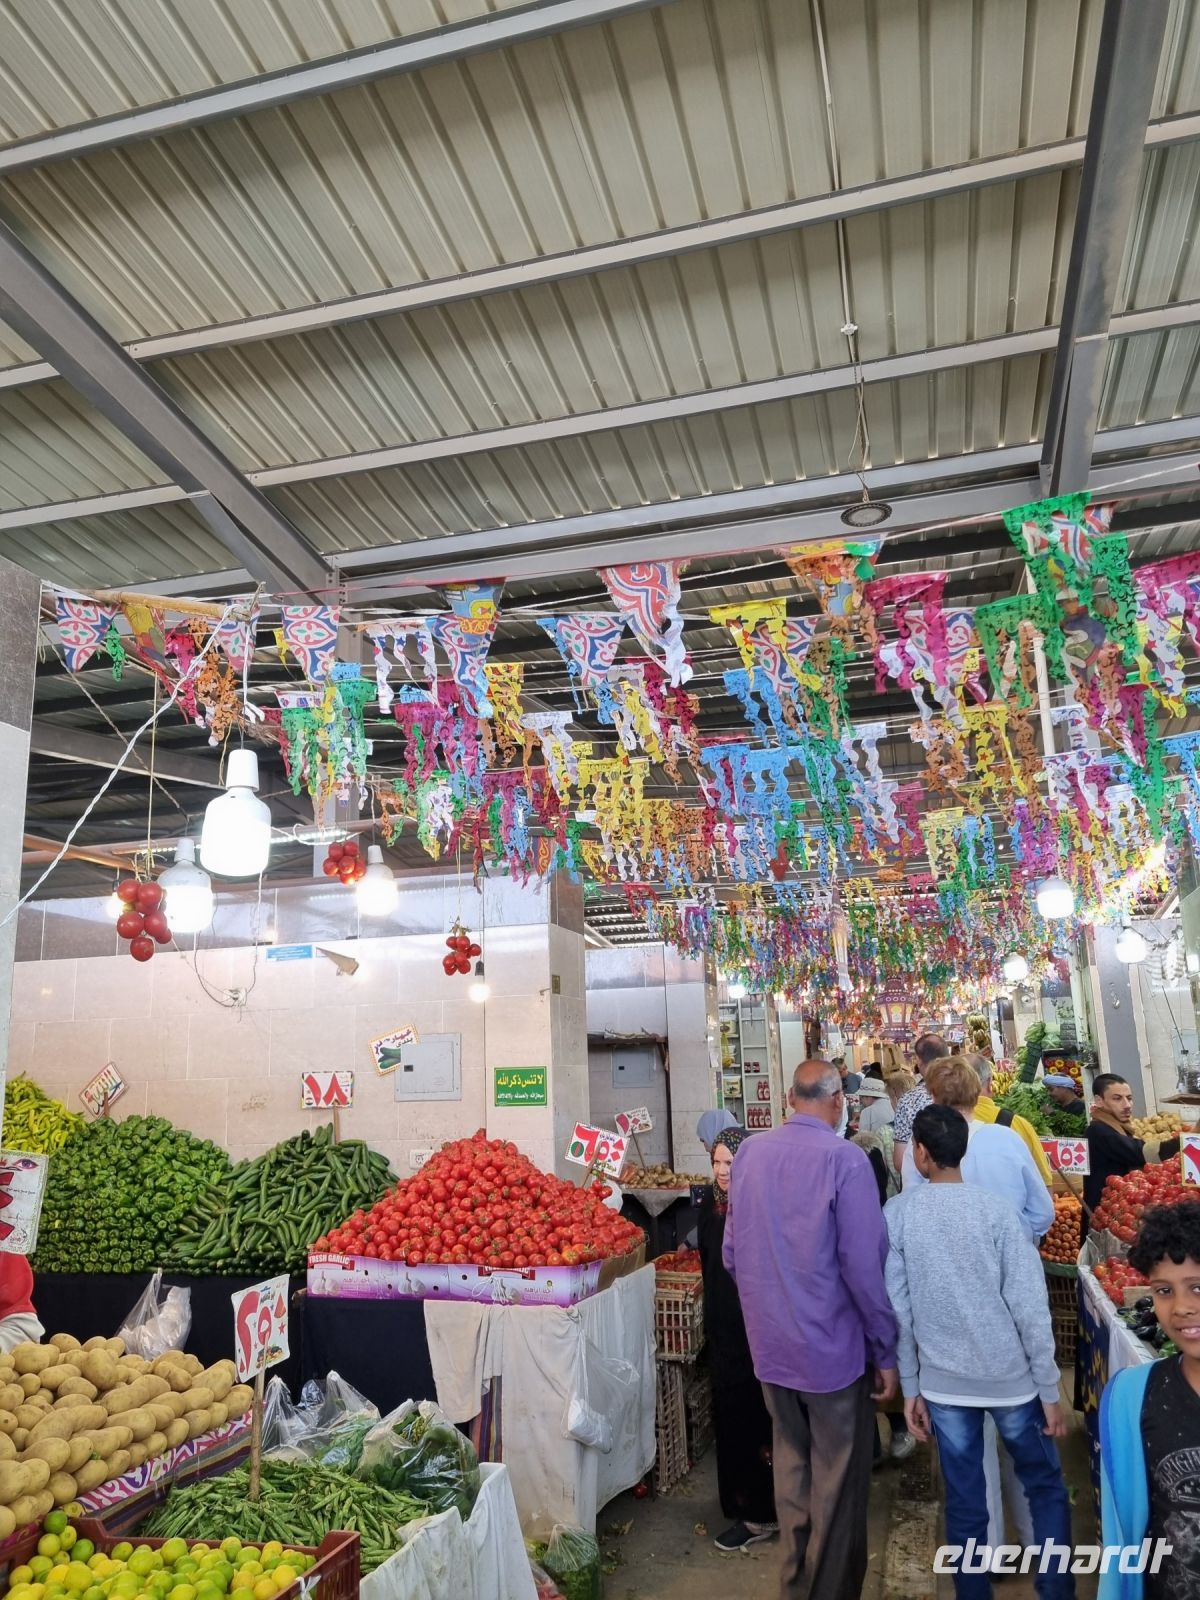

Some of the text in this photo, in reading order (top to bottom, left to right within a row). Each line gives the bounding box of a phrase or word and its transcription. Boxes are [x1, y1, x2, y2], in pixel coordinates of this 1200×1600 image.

[497, 1072, 509, 1085] الله
[508, 1074, 522, 1088] ذكر
[304, 1073, 348, 1106] ١٨
[309, 1253, 350, 1265] FRESH GARLIC
